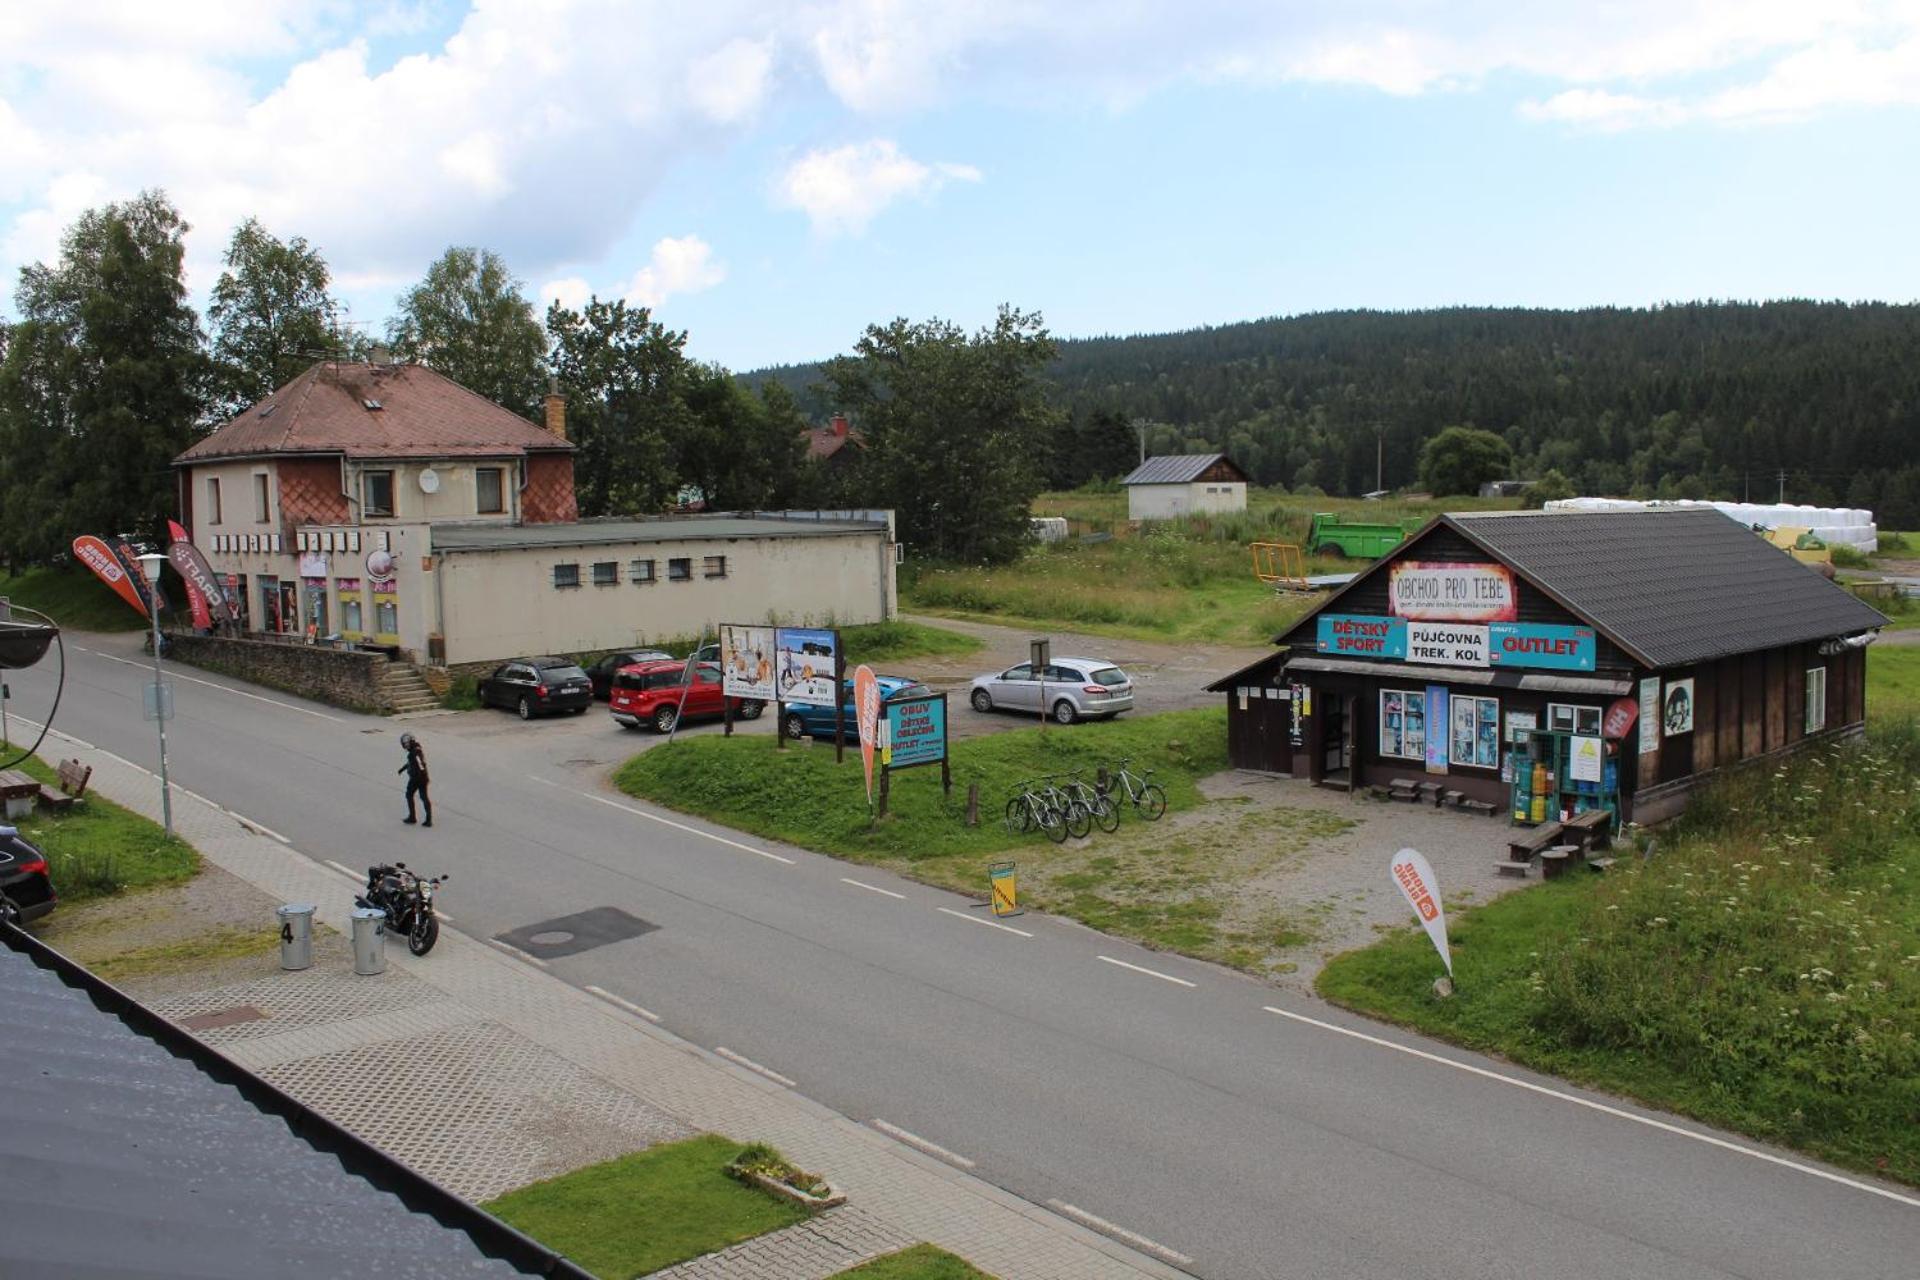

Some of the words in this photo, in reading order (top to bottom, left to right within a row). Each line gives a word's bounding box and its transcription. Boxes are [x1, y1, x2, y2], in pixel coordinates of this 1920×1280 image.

[1397, 577, 1439, 599] OBCHOD
[1445, 577, 1468, 599] PRO
[1473, 577, 1504, 599] TEBE
[1333, 619, 1390, 637] DĚTSKÝ
[1412, 629, 1482, 645] PŮJČOVNA
[1336, 637, 1385, 652] SPORT
[1412, 646, 1450, 659] TREK.
[1455, 649, 1481, 661] KOL
[1502, 636, 1579, 655] OUTLET
[1604, 708, 1629, 736] HH
[281, 922, 294, 944] 4
